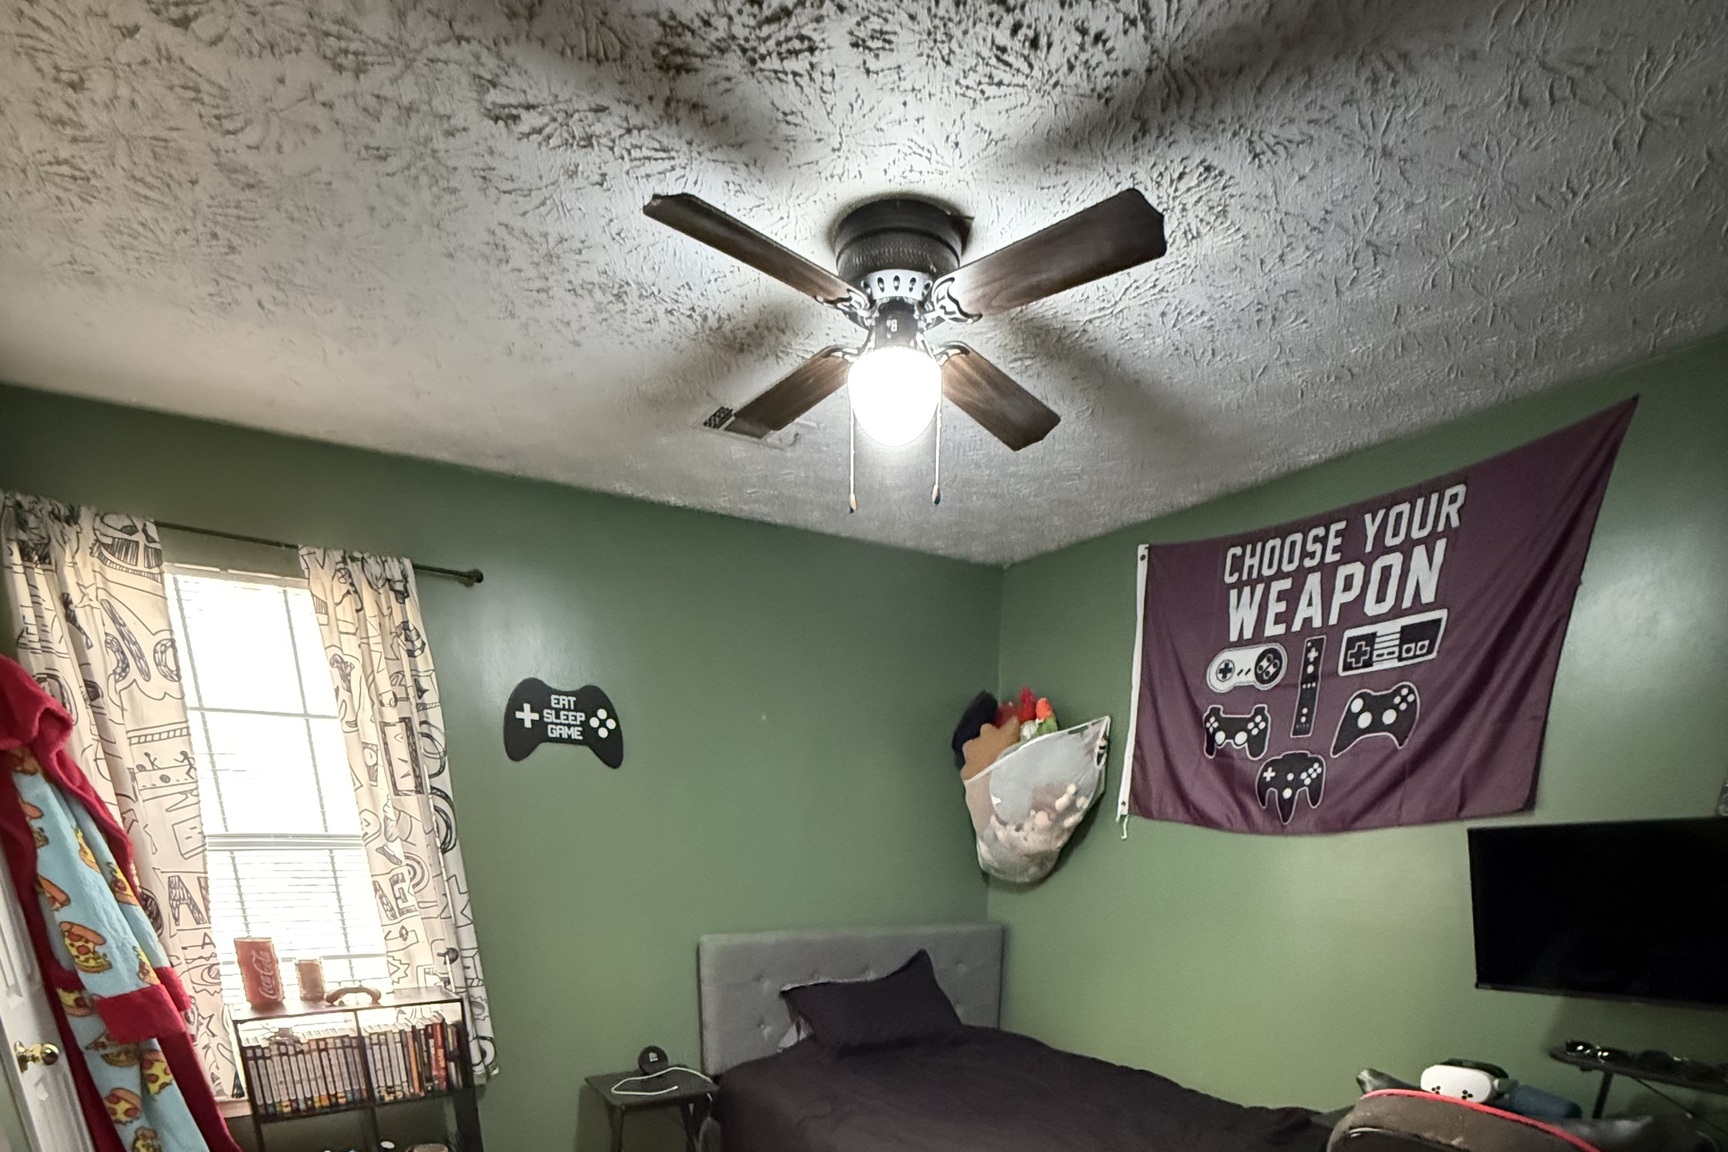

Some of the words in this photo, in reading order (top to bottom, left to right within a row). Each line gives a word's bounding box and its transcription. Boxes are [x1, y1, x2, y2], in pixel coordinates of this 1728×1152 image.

[1223, 520, 1348, 584] CHOOSE
[1363, 481, 1468, 554] YOUR
[1228, 537, 1447, 642] WEAPON
[550, 694, 577, 710] EAT
[543, 708, 585, 725] SLEEP
[547, 724, 583, 740] GAME
